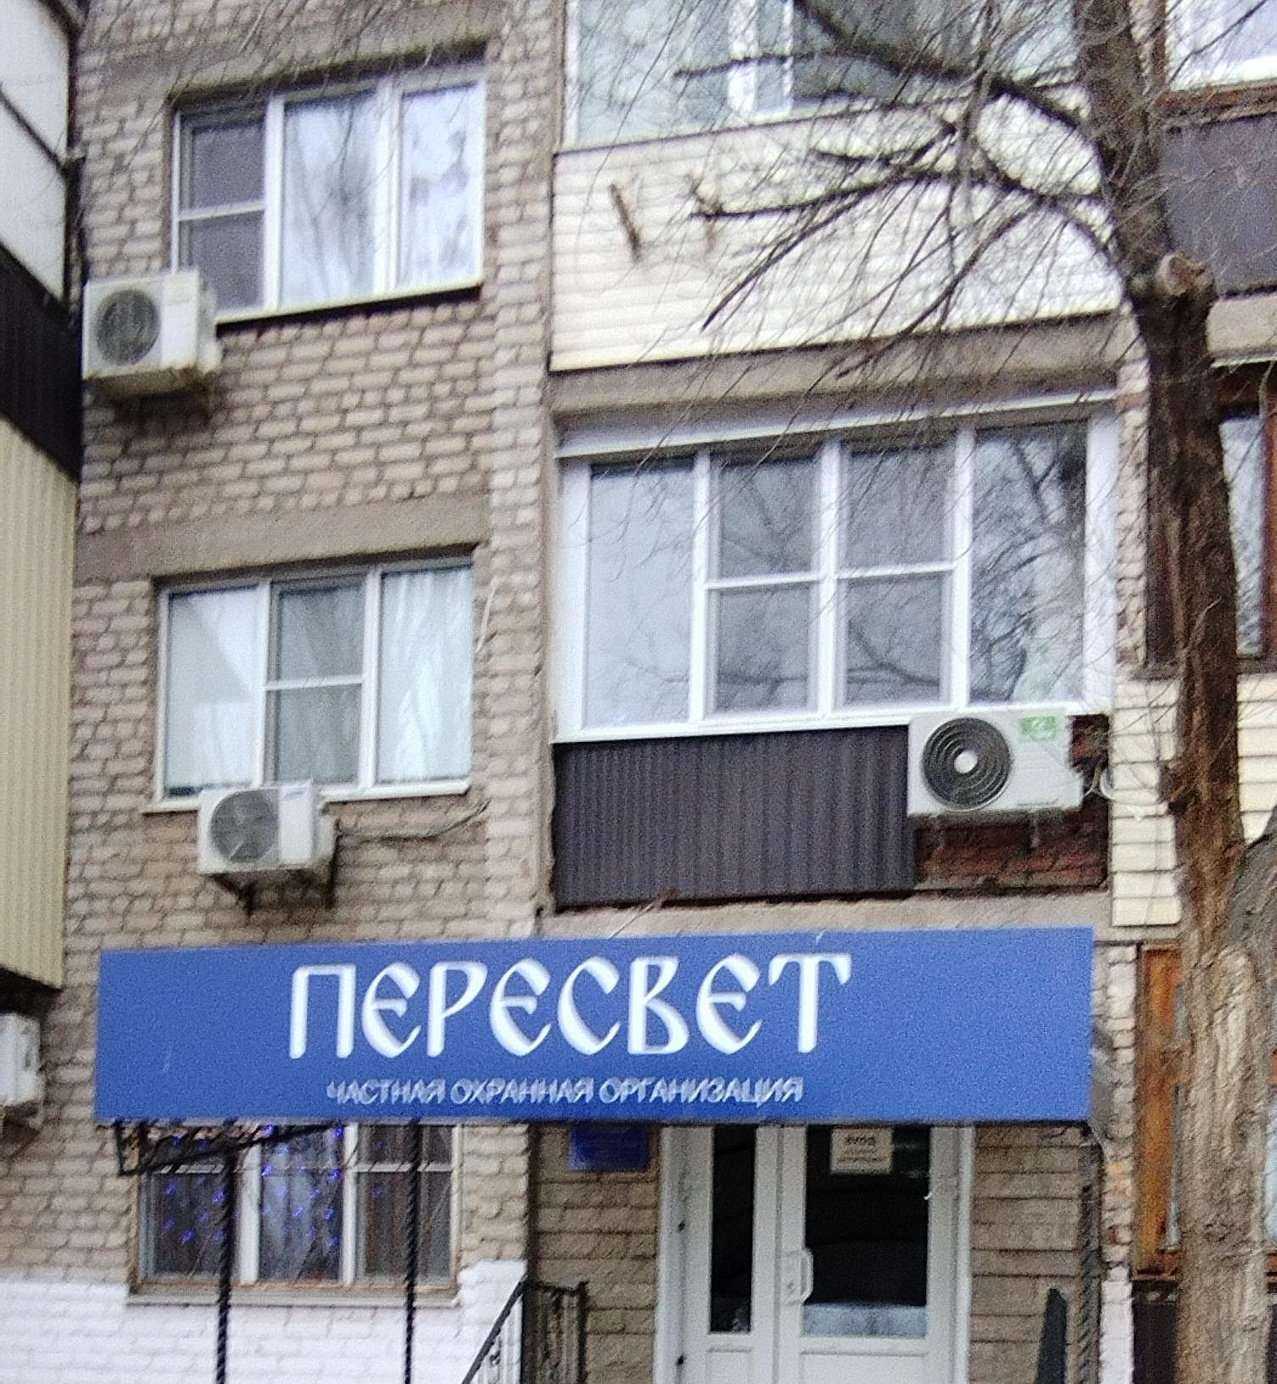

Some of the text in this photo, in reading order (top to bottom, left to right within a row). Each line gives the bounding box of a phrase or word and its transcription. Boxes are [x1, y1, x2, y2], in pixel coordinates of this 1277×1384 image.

[289, 952, 851, 1059] ПЕРЕСВЕТ
[326, 1076, 803, 1108] ЧАСТНАЯ ОХРАННАЯ ОРГАНИЗАЦИЯ
